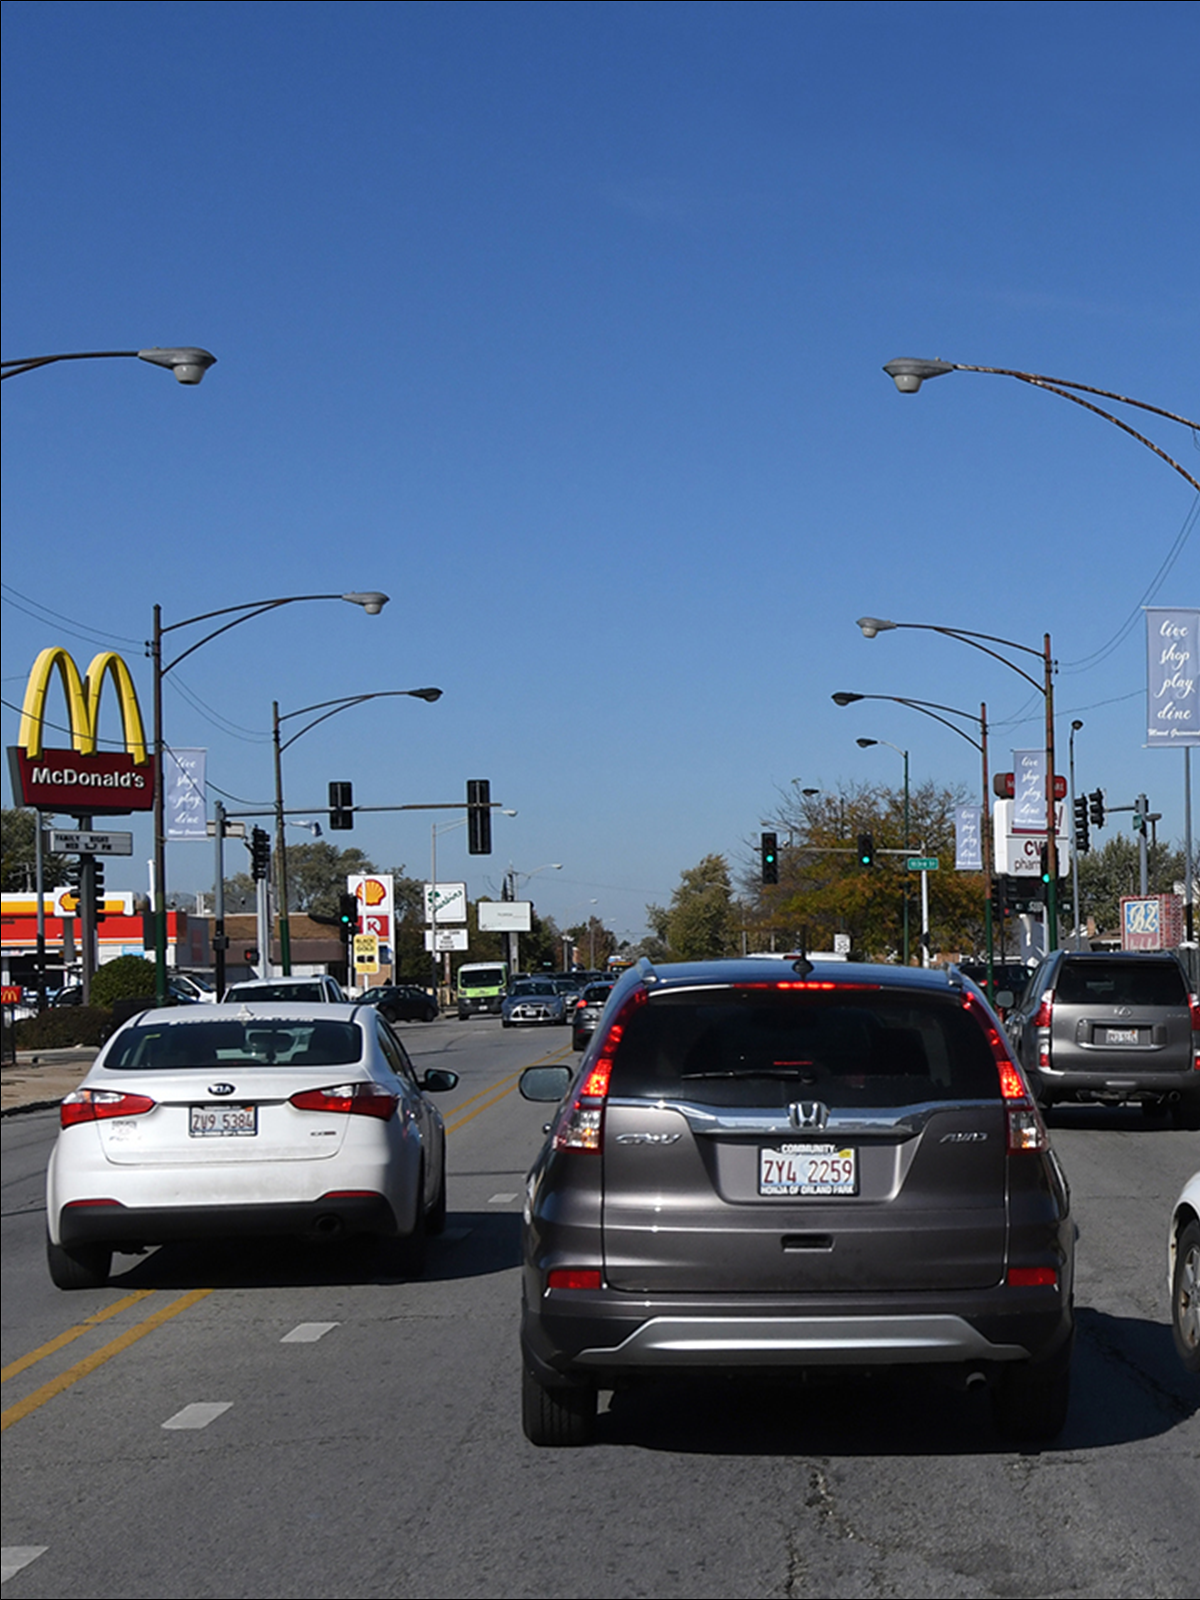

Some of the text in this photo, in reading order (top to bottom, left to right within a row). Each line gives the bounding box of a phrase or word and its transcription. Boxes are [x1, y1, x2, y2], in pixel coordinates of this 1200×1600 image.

[1159, 619, 1189, 637] live
[1159, 642, 1191, 671] shop
[1153, 672, 1196, 699] play
[1157, 701, 1192, 720] dine
[31, 766, 146, 789] McDonald's
[781, 1144, 836, 1154] COMMUNITY
[763, 1160, 853, 1183] ZY4 2259
[761, 1185, 855, 1195] HONDA OF ORLAND PARK
